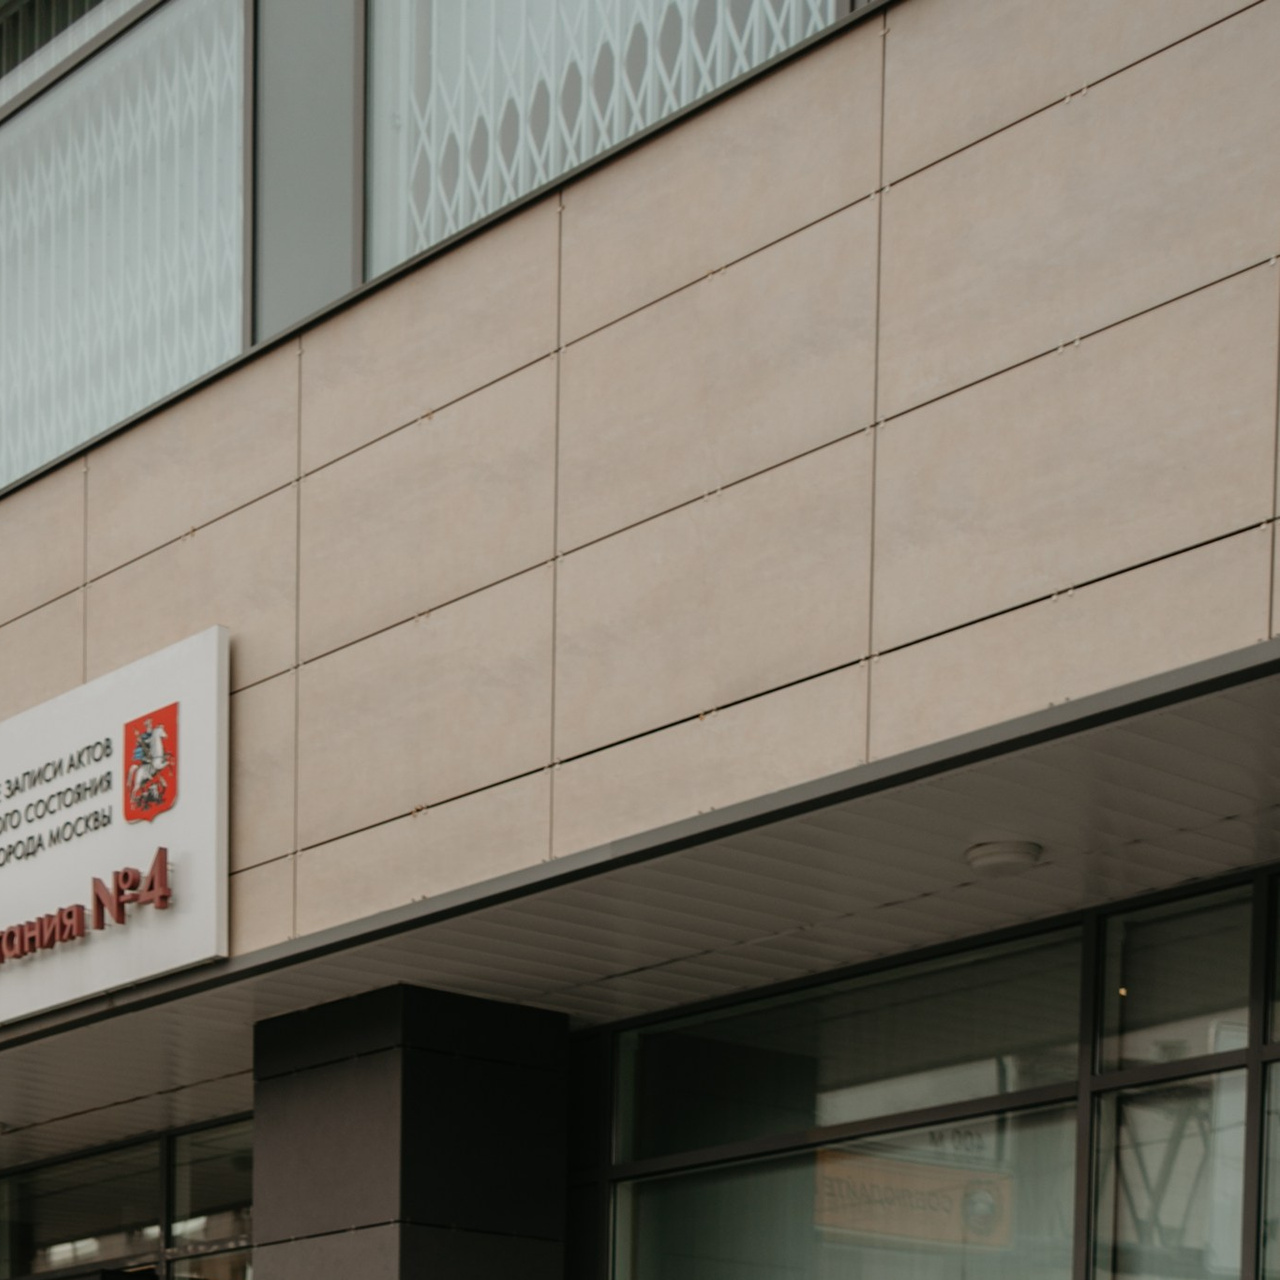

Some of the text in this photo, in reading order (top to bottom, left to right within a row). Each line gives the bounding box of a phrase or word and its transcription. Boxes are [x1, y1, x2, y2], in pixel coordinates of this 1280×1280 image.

[5, 758, 64, 798] ЗАПИСИ
[67, 738, 113, 774] АКТОВ
[25, 771, 113, 823] СОСТОЯНИЯ
[48, 805, 113, 847] МОСКВЫ
[92, 847, 172, 929] №4
